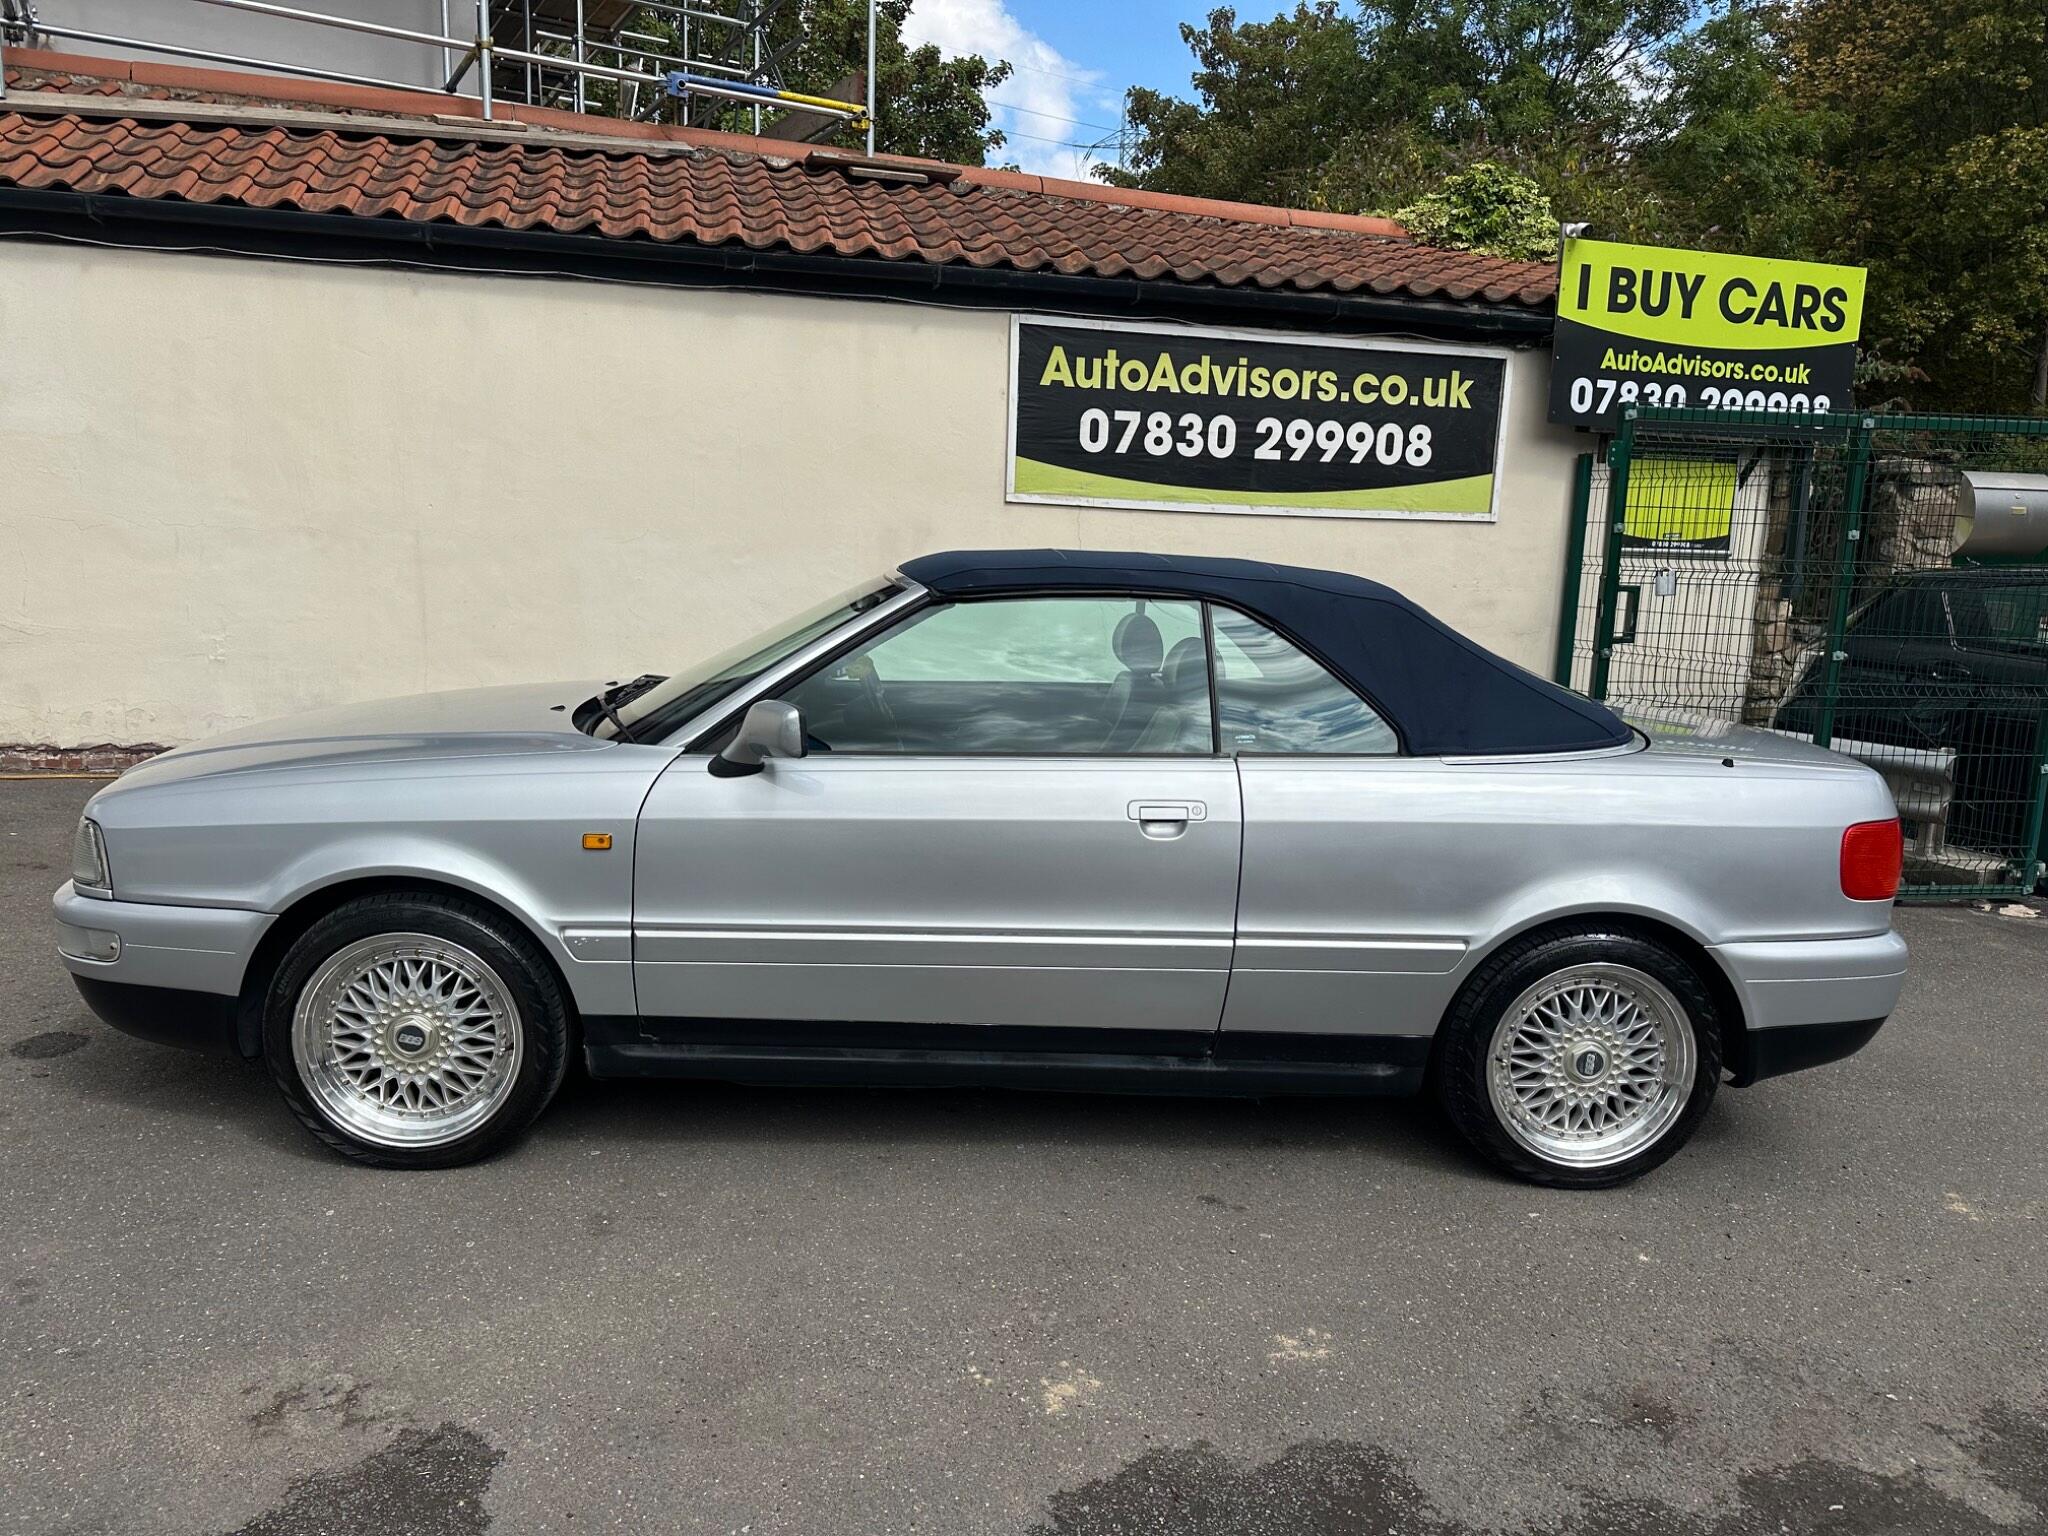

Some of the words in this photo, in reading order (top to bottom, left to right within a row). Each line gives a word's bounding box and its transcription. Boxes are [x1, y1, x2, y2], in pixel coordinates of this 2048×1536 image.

[1577, 263, 1592, 311] I
[1606, 266, 1706, 319] BUY
[1718, 277, 1848, 333] CARS
[1039, 345, 1475, 409] AutoAdvisors.co.uk
[1600, 347, 1812, 385] AutoAdvisors.co.uk
[1078, 407, 1237, 459] 07830
[1253, 416, 1433, 467] 299908
